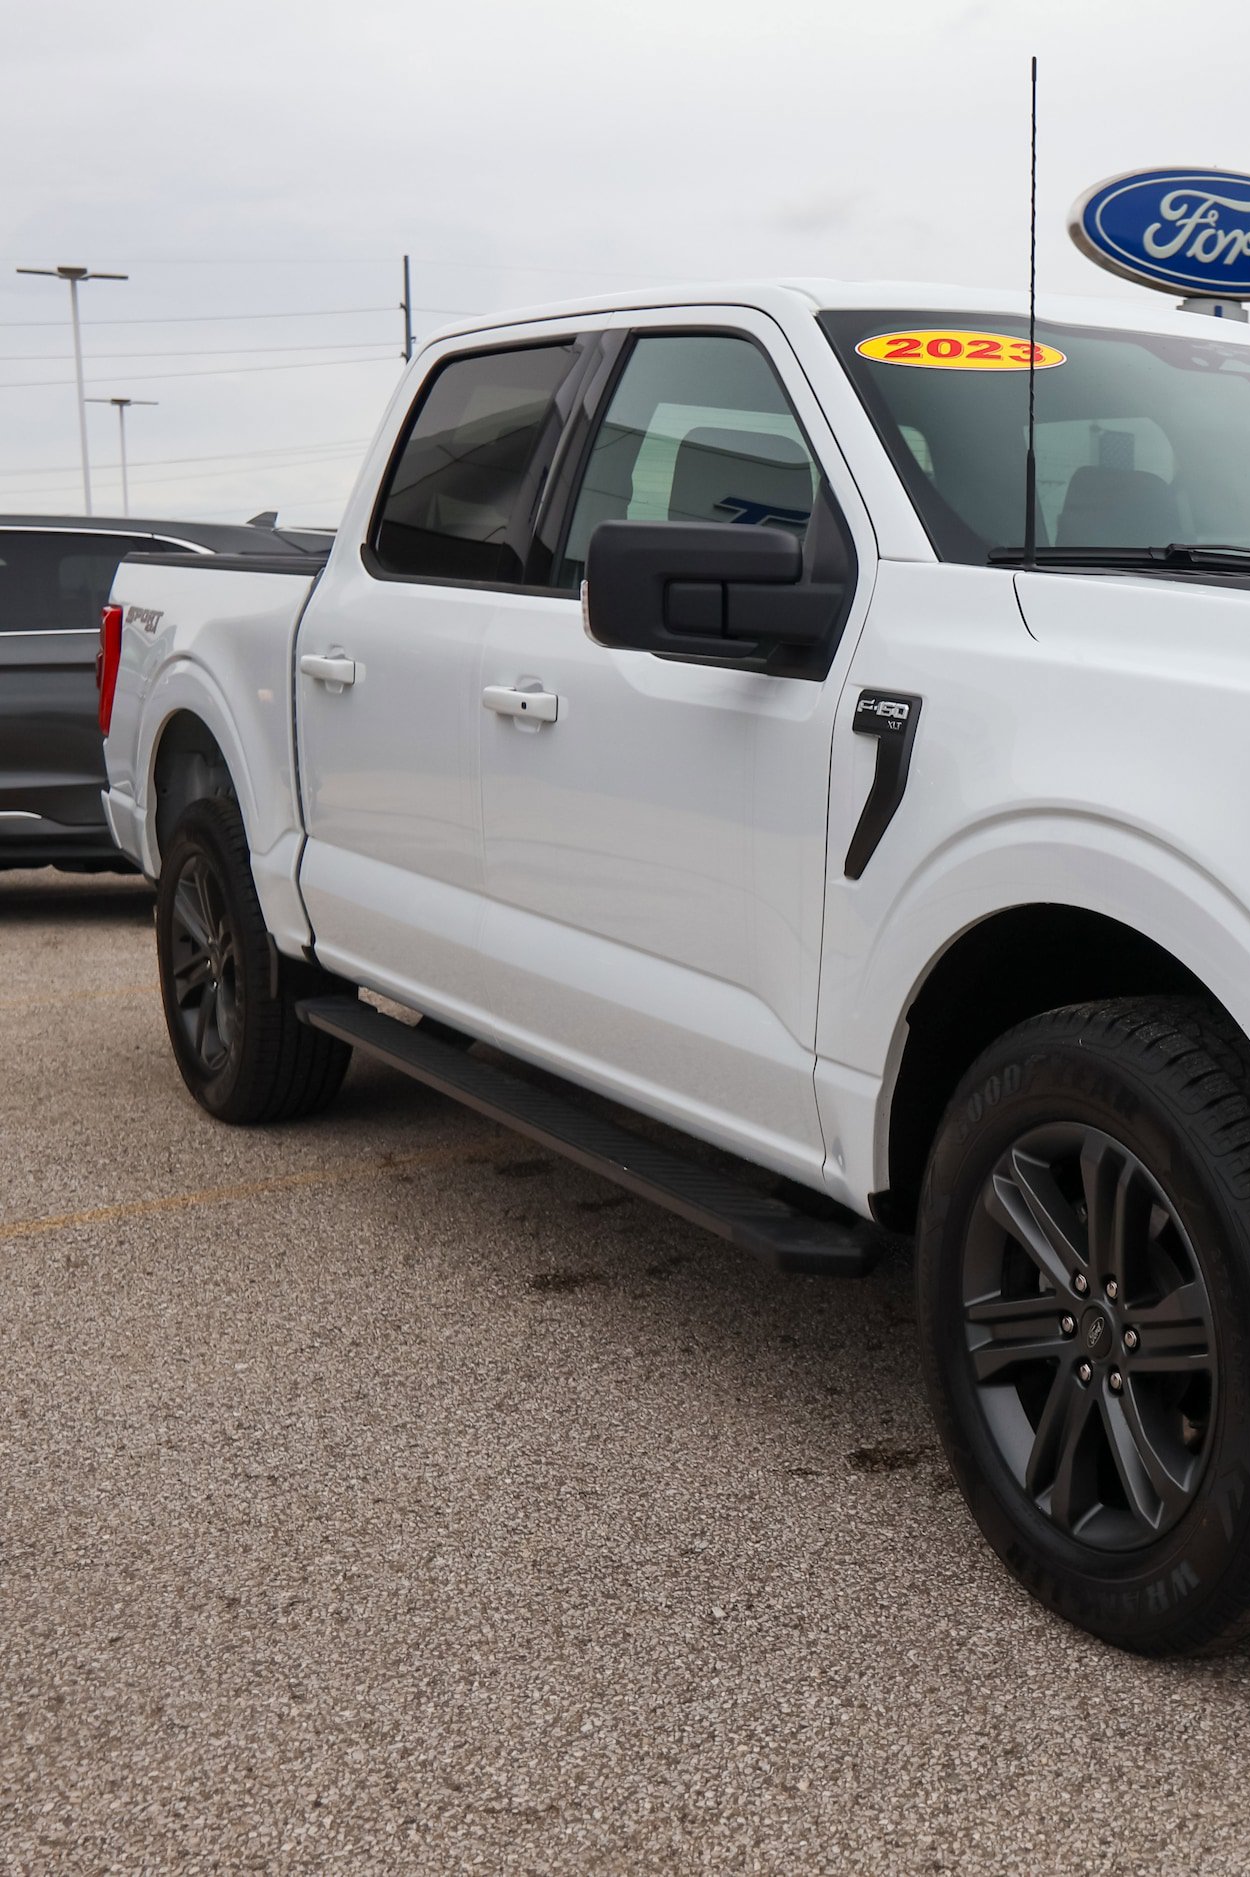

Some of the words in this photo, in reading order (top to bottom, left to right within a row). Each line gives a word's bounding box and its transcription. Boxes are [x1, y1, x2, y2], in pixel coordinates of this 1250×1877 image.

[884, 338, 1046, 364] 2023
[857, 699, 910, 720] F-150
[887, 720, 903, 731] XLT
